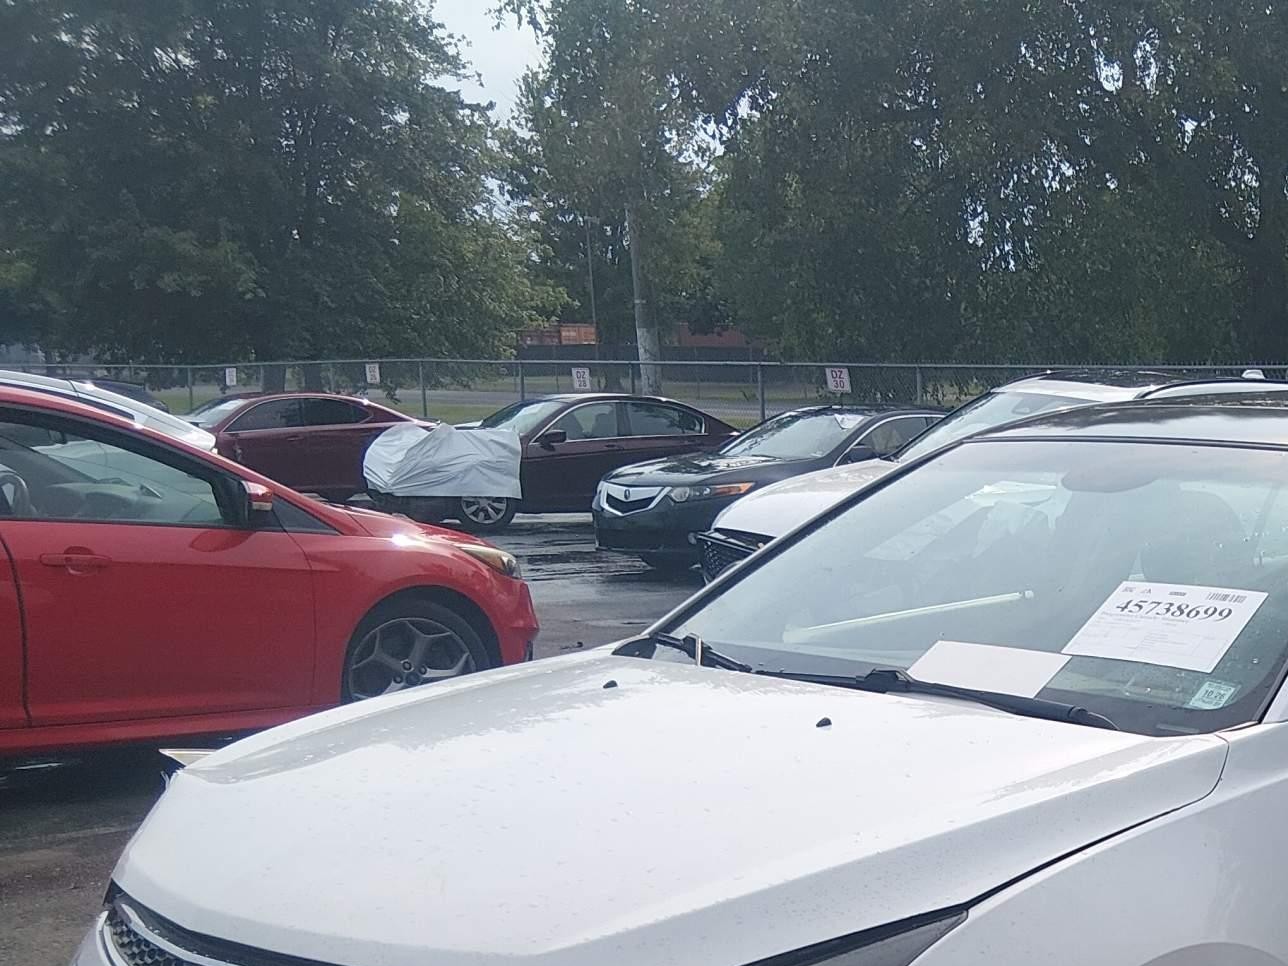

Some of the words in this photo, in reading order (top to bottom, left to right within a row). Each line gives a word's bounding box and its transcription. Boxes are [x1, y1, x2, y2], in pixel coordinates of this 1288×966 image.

[831, 370, 845, 379] DZ
[833, 380, 845, 389] 30
[1116, 599, 1233, 622] 45738699
